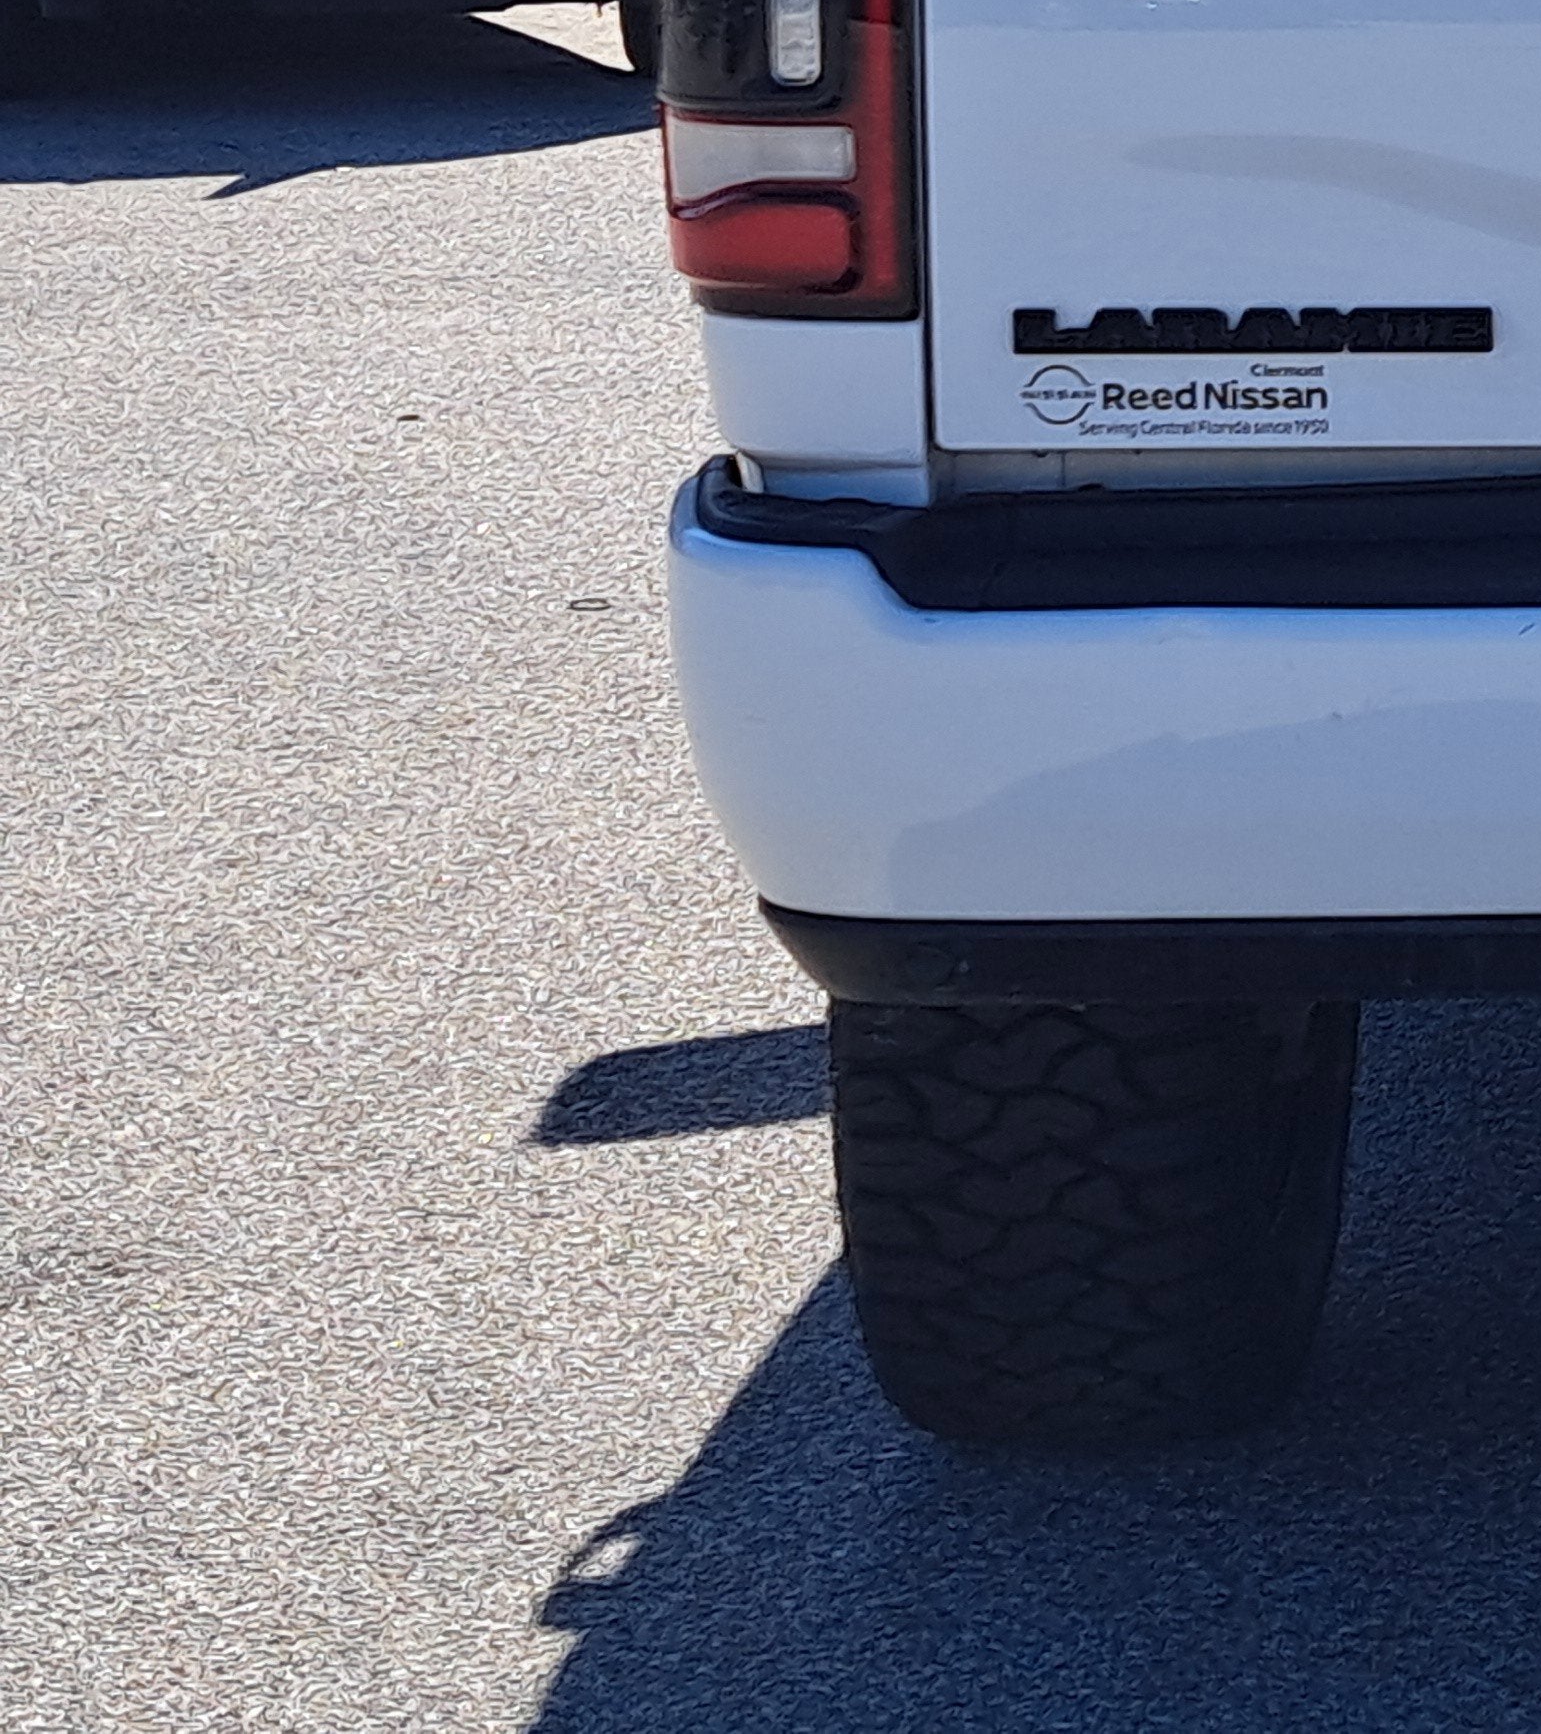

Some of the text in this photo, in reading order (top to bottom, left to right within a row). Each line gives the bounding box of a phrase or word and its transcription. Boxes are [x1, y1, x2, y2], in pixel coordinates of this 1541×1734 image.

[1013, 307, 1494, 354] LARAMIE
[1250, 363, 1324, 377] Clermont
[1102, 379, 1328, 411] Reed Nissan
